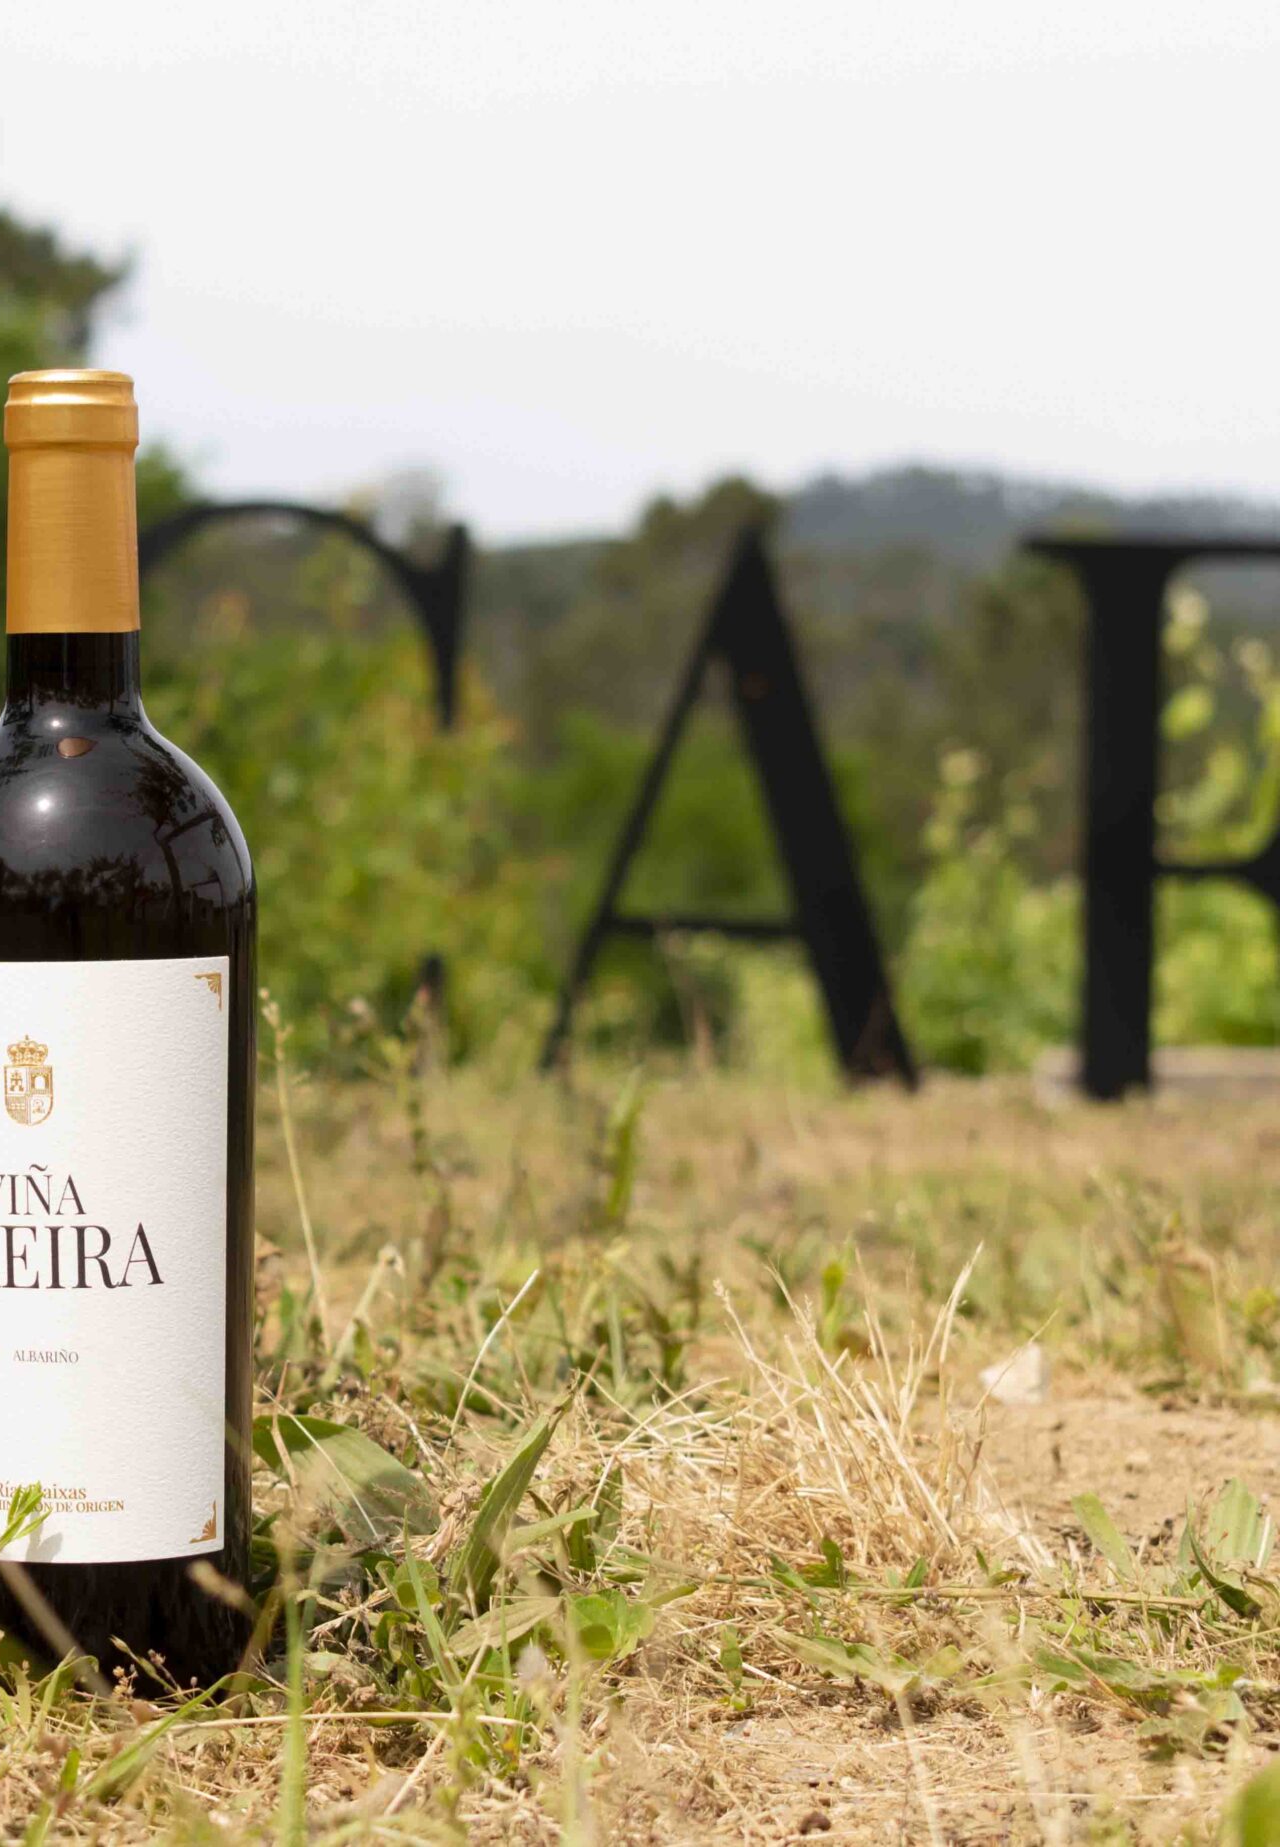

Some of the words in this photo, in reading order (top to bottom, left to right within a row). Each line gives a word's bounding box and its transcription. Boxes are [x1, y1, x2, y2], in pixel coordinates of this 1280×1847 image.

[12, 1347, 80, 1364] ALBARIÑO
[28, 1483, 87, 1500] aixas
[56, 1501, 73, 1513] DE
[75, 1499, 125, 1513] ORIGEN
